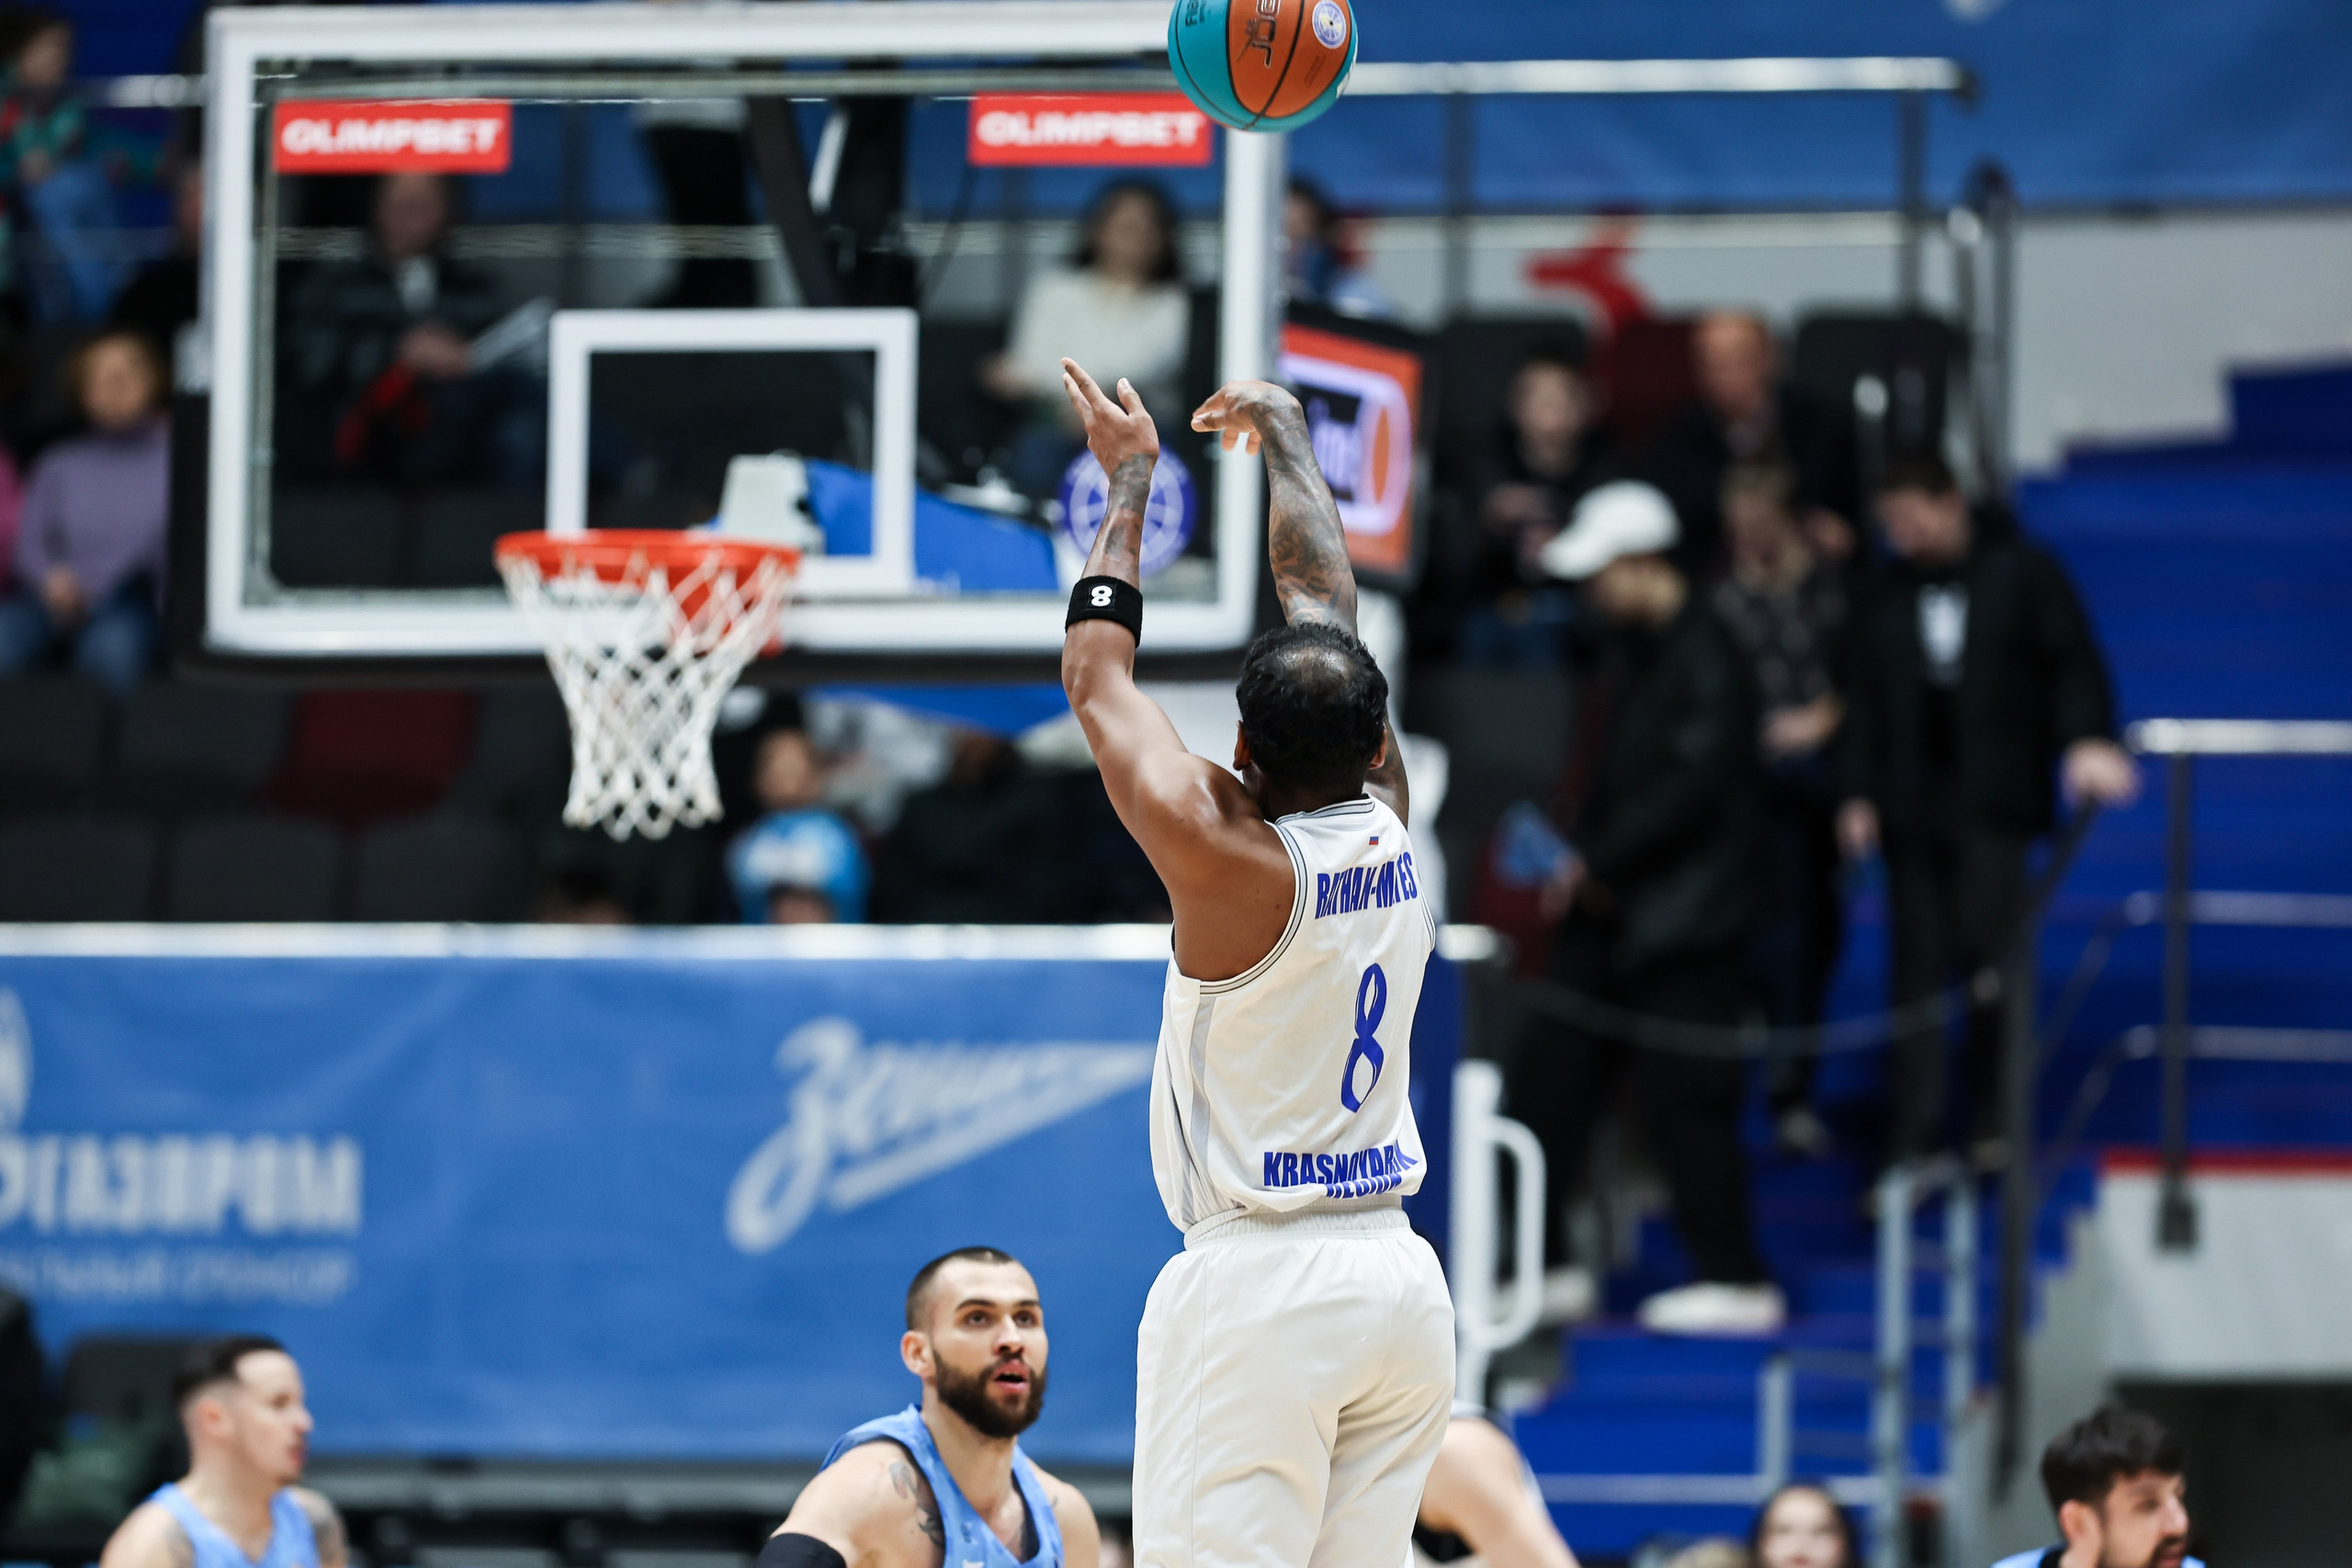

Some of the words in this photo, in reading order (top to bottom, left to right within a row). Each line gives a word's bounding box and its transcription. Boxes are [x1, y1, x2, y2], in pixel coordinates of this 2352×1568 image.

[281, 117, 503, 154] OLIMPBET
[976, 110, 1206, 147] OLIMPBET
[1091, 584, 1114, 607] 8
[1340, 963, 1387, 1113] 8
[1263, 1139, 1419, 1187] KRASNOYARK
